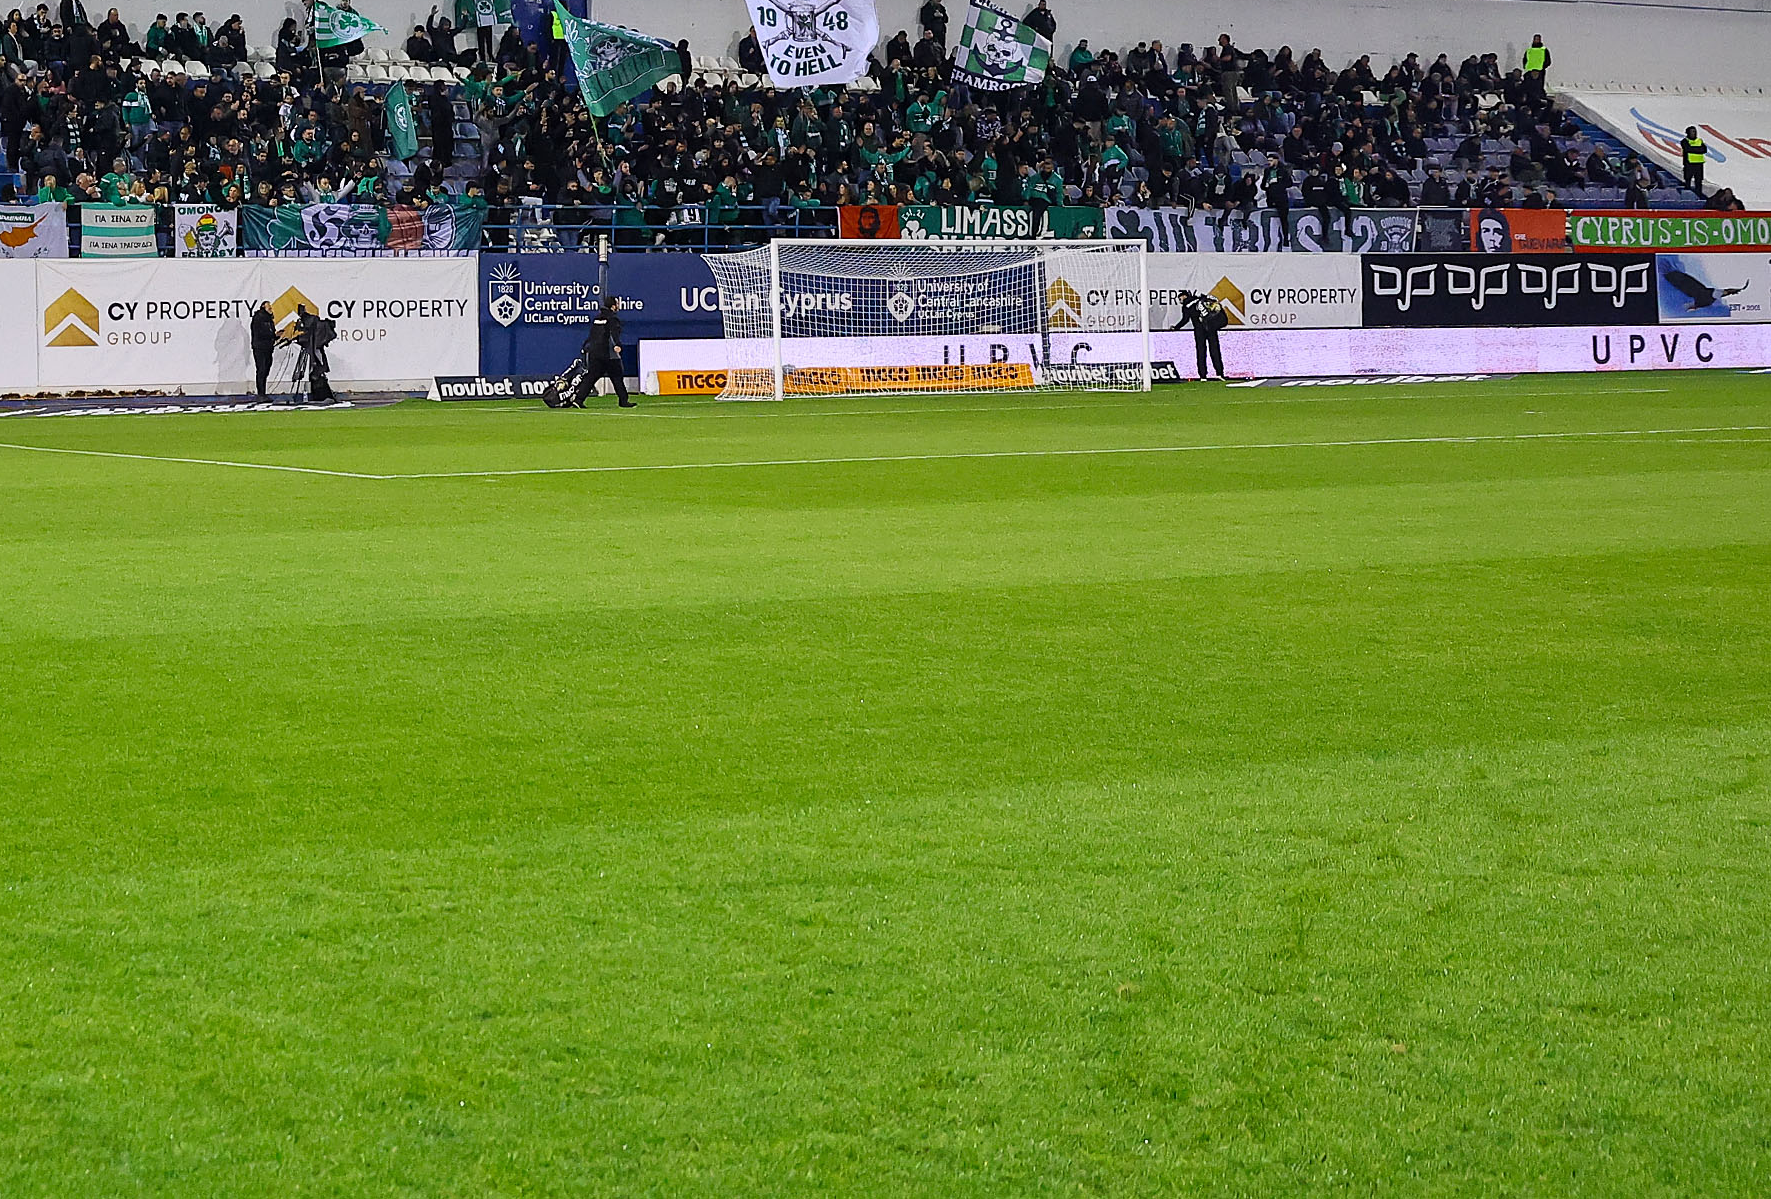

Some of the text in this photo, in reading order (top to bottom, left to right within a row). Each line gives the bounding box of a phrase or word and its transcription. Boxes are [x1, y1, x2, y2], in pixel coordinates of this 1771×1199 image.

[757, 6, 848, 31] 19 48
[783, 43, 827, 59] EVEN
[769, 54, 843, 77] TO HELL
[111, 214, 132, 223] ΣΕΝΑ
[941, 206, 1054, 237] LIMASSL
[497, 285, 514, 294] 1828
[524, 281, 589, 298] University
[917, 280, 975, 294] University
[524, 296, 644, 311] Central Lanhire
[681, 287, 760, 312] UCLan
[917, 295, 1022, 307] Central Lancashire
[1087, 290, 1109, 306] CY
[1250, 288, 1357, 304] CY PROPERTY
[108, 300, 258, 321] CY PROPERTY
[327, 299, 469, 318] CY PROPERTY
[524, 313, 555, 323] UCLan
[557, 313, 590, 325] Cyprus
[1250, 313, 1297, 325] GROUP
[108, 331, 172, 345] GROUP
[338, 329, 387, 341] ROUP
[1114, 362, 1177, 383] novbet
[441, 377, 514, 398] novibet
